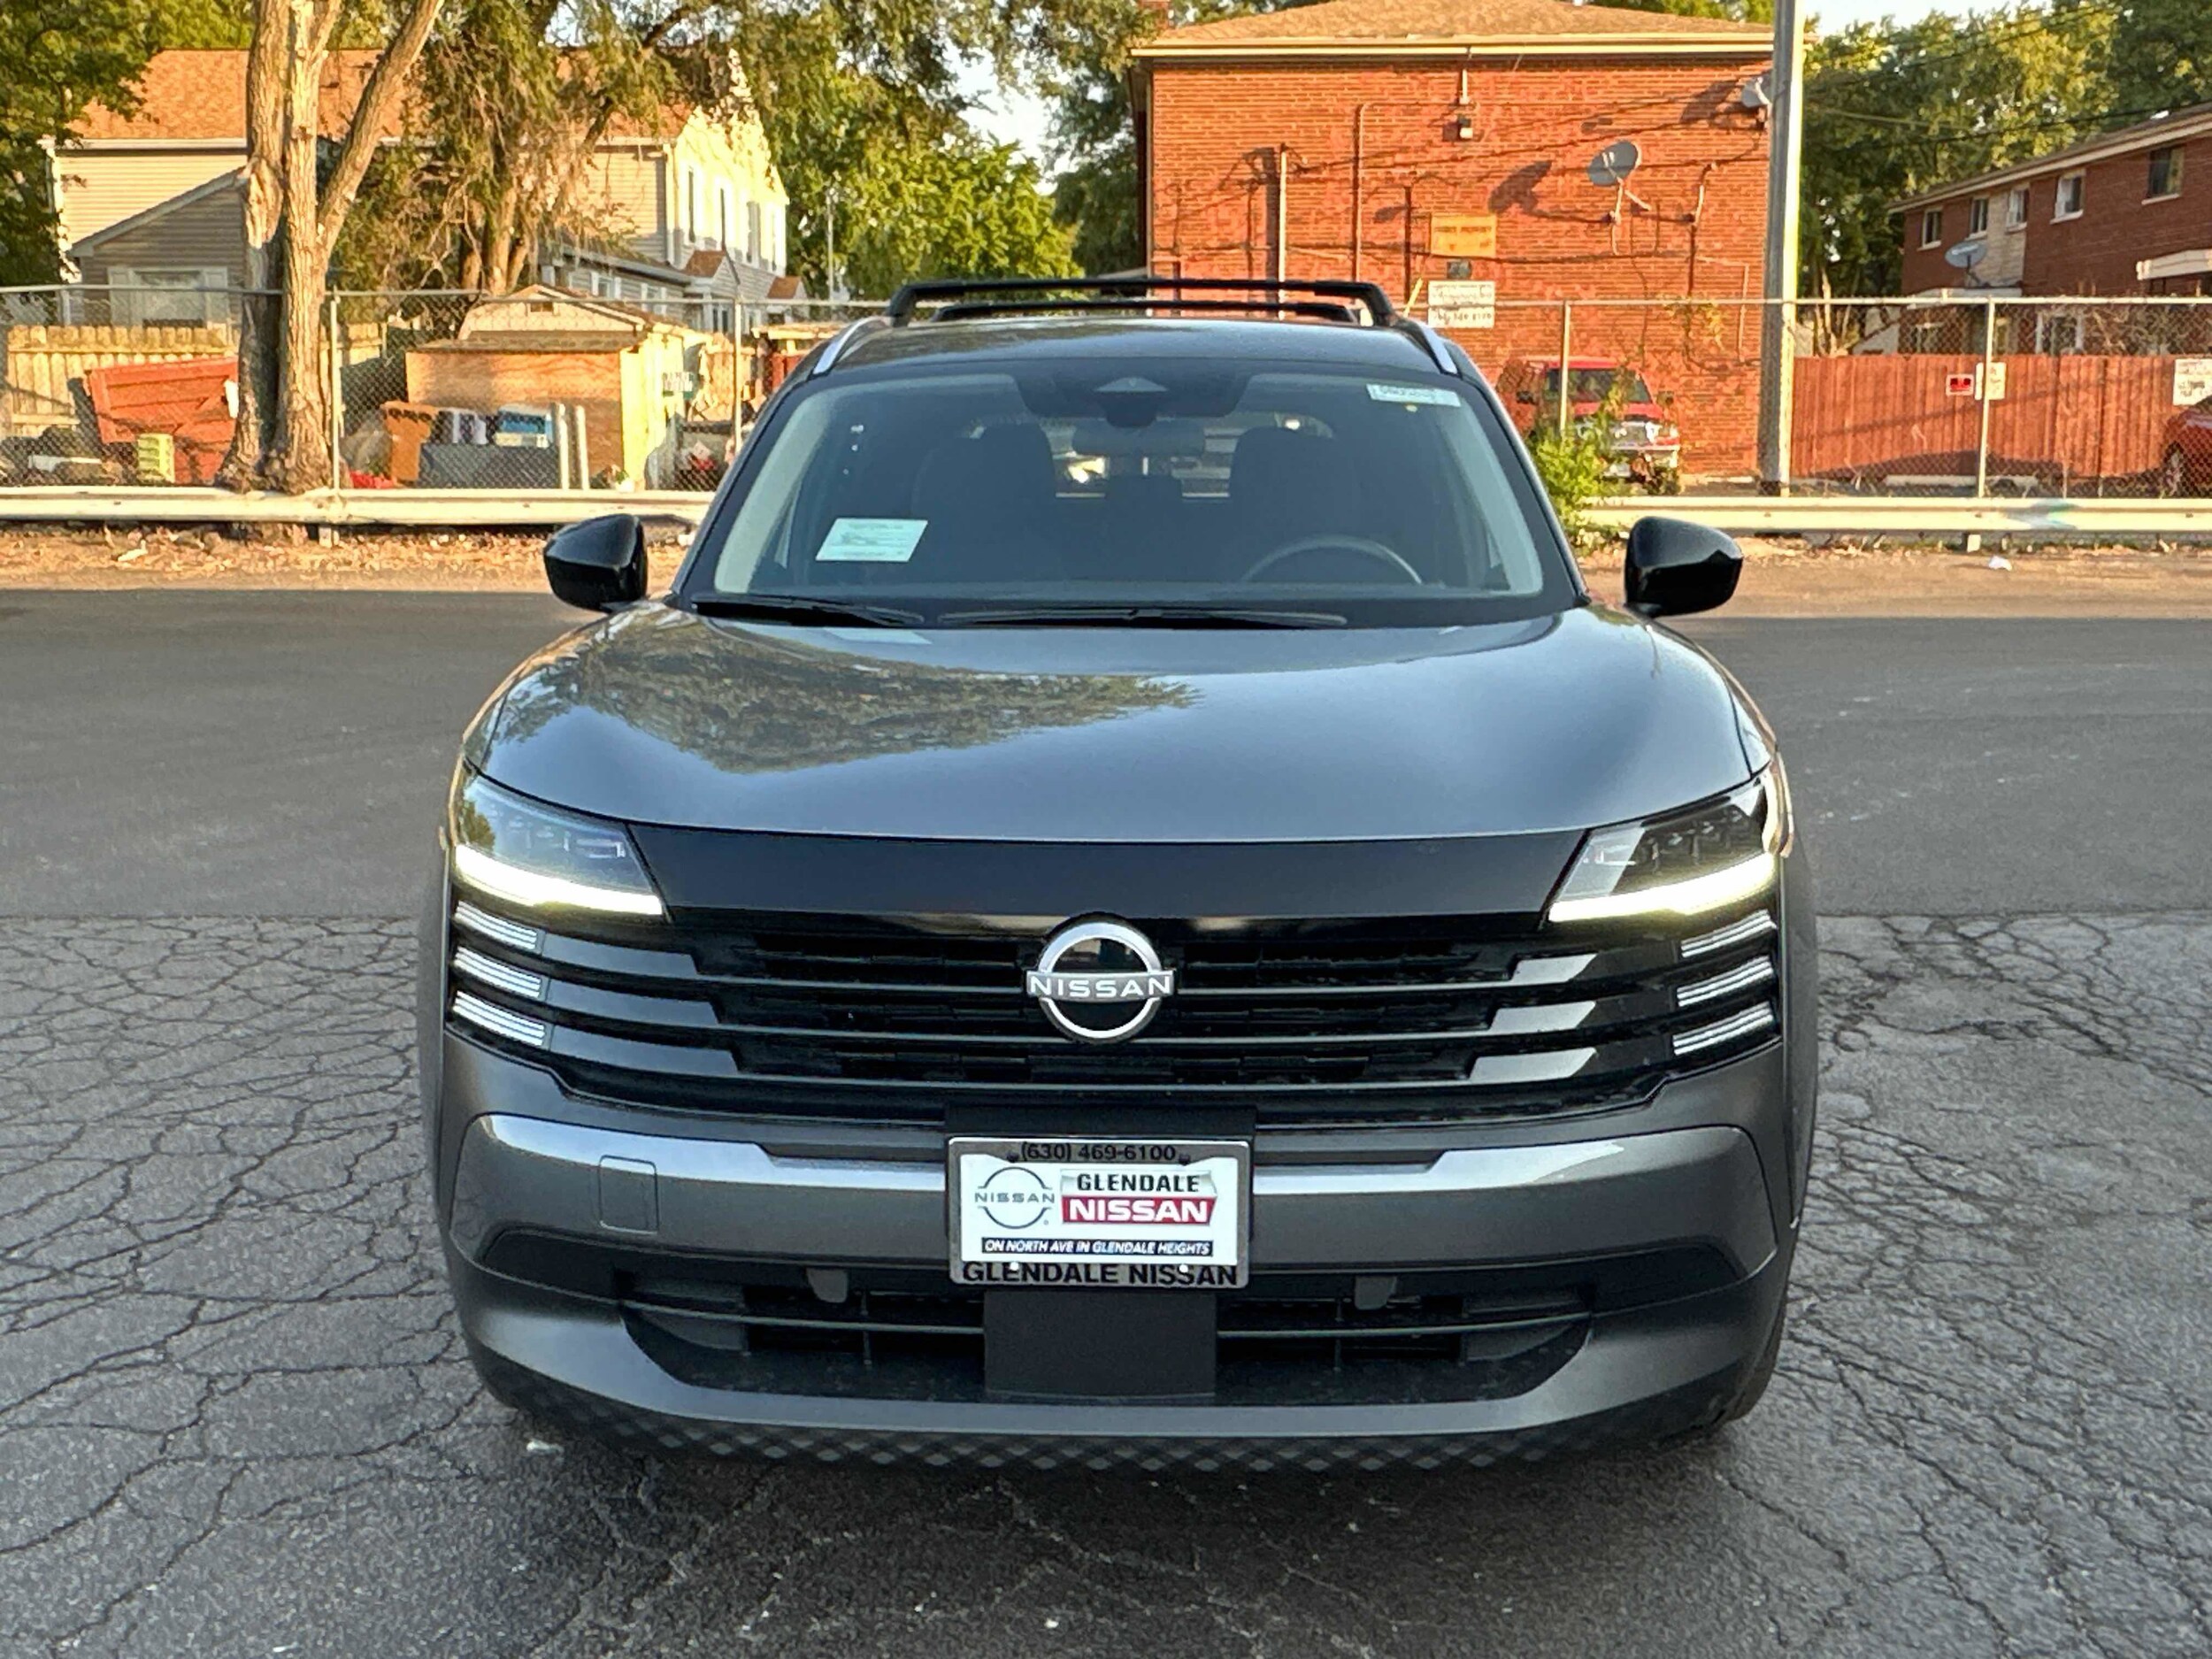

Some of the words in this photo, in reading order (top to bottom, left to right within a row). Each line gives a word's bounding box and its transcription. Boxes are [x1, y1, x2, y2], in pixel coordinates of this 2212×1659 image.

[1030, 976, 1171, 998] NISSAN
[1021, 1141, 1071, 1162] (630)
[1078, 1143, 1177, 1162] 469-6100
[1077, 1173, 1200, 1193] GLENDALE
[974, 1192, 1056, 1204] NISSAN
[1069, 1198, 1209, 1223] NISSAN
[984, 1240, 1005, 1253] ON
[1006, 1240, 1048, 1254] NORTH
[1049, 1240, 1074, 1254] AVE
[1075, 1240, 1091, 1255] IN
[1092, 1240, 1156, 1256] GLENDALE
[1157, 1242, 1210, 1256] HEIGHTS
[962, 1261, 1119, 1283] GLENDALE
[1129, 1263, 1238, 1286] NISSAN
